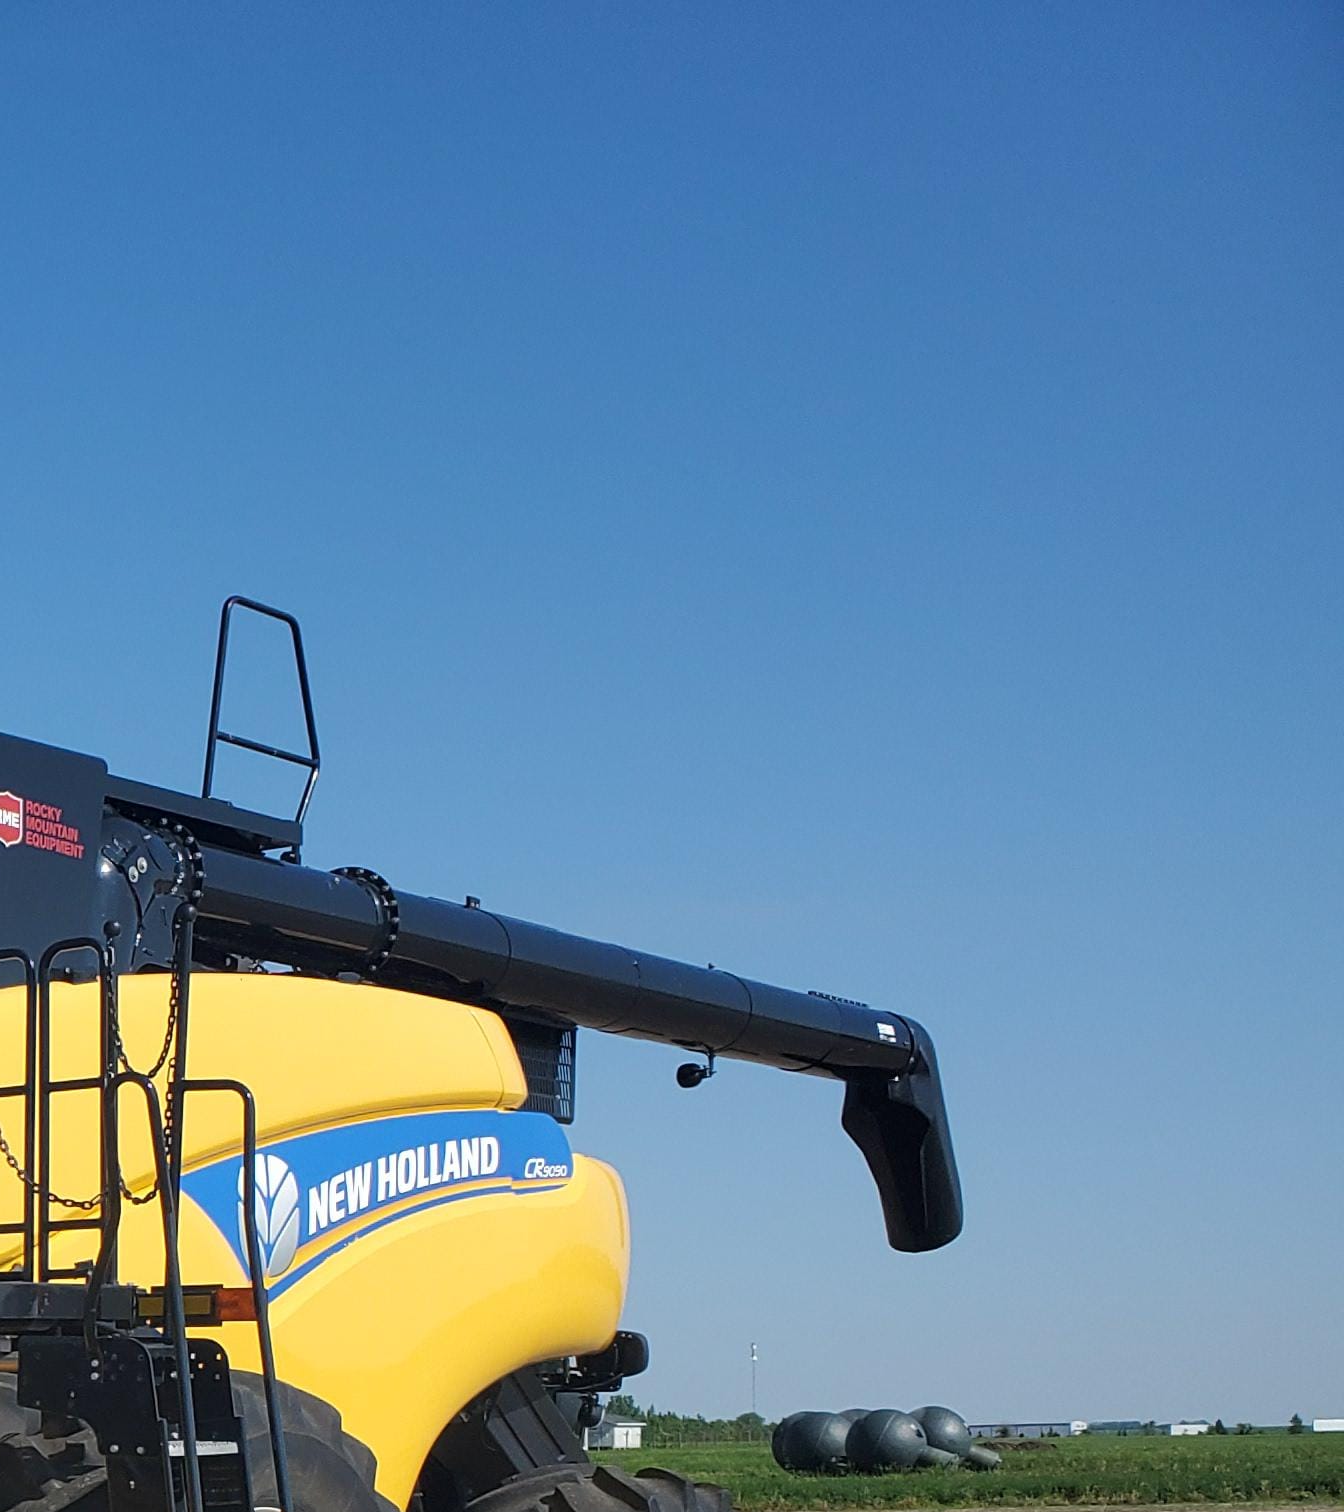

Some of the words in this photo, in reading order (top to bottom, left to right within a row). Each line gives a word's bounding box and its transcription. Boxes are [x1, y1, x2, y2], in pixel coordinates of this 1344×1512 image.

[25, 800, 62, 823] ROCKY
[25, 815, 78, 843] MOUNTAIN
[25, 831, 85, 860] EQUIPMENT
[308, 1170, 372, 1236] NEW
[376, 1136, 500, 1203] HOLLAND
